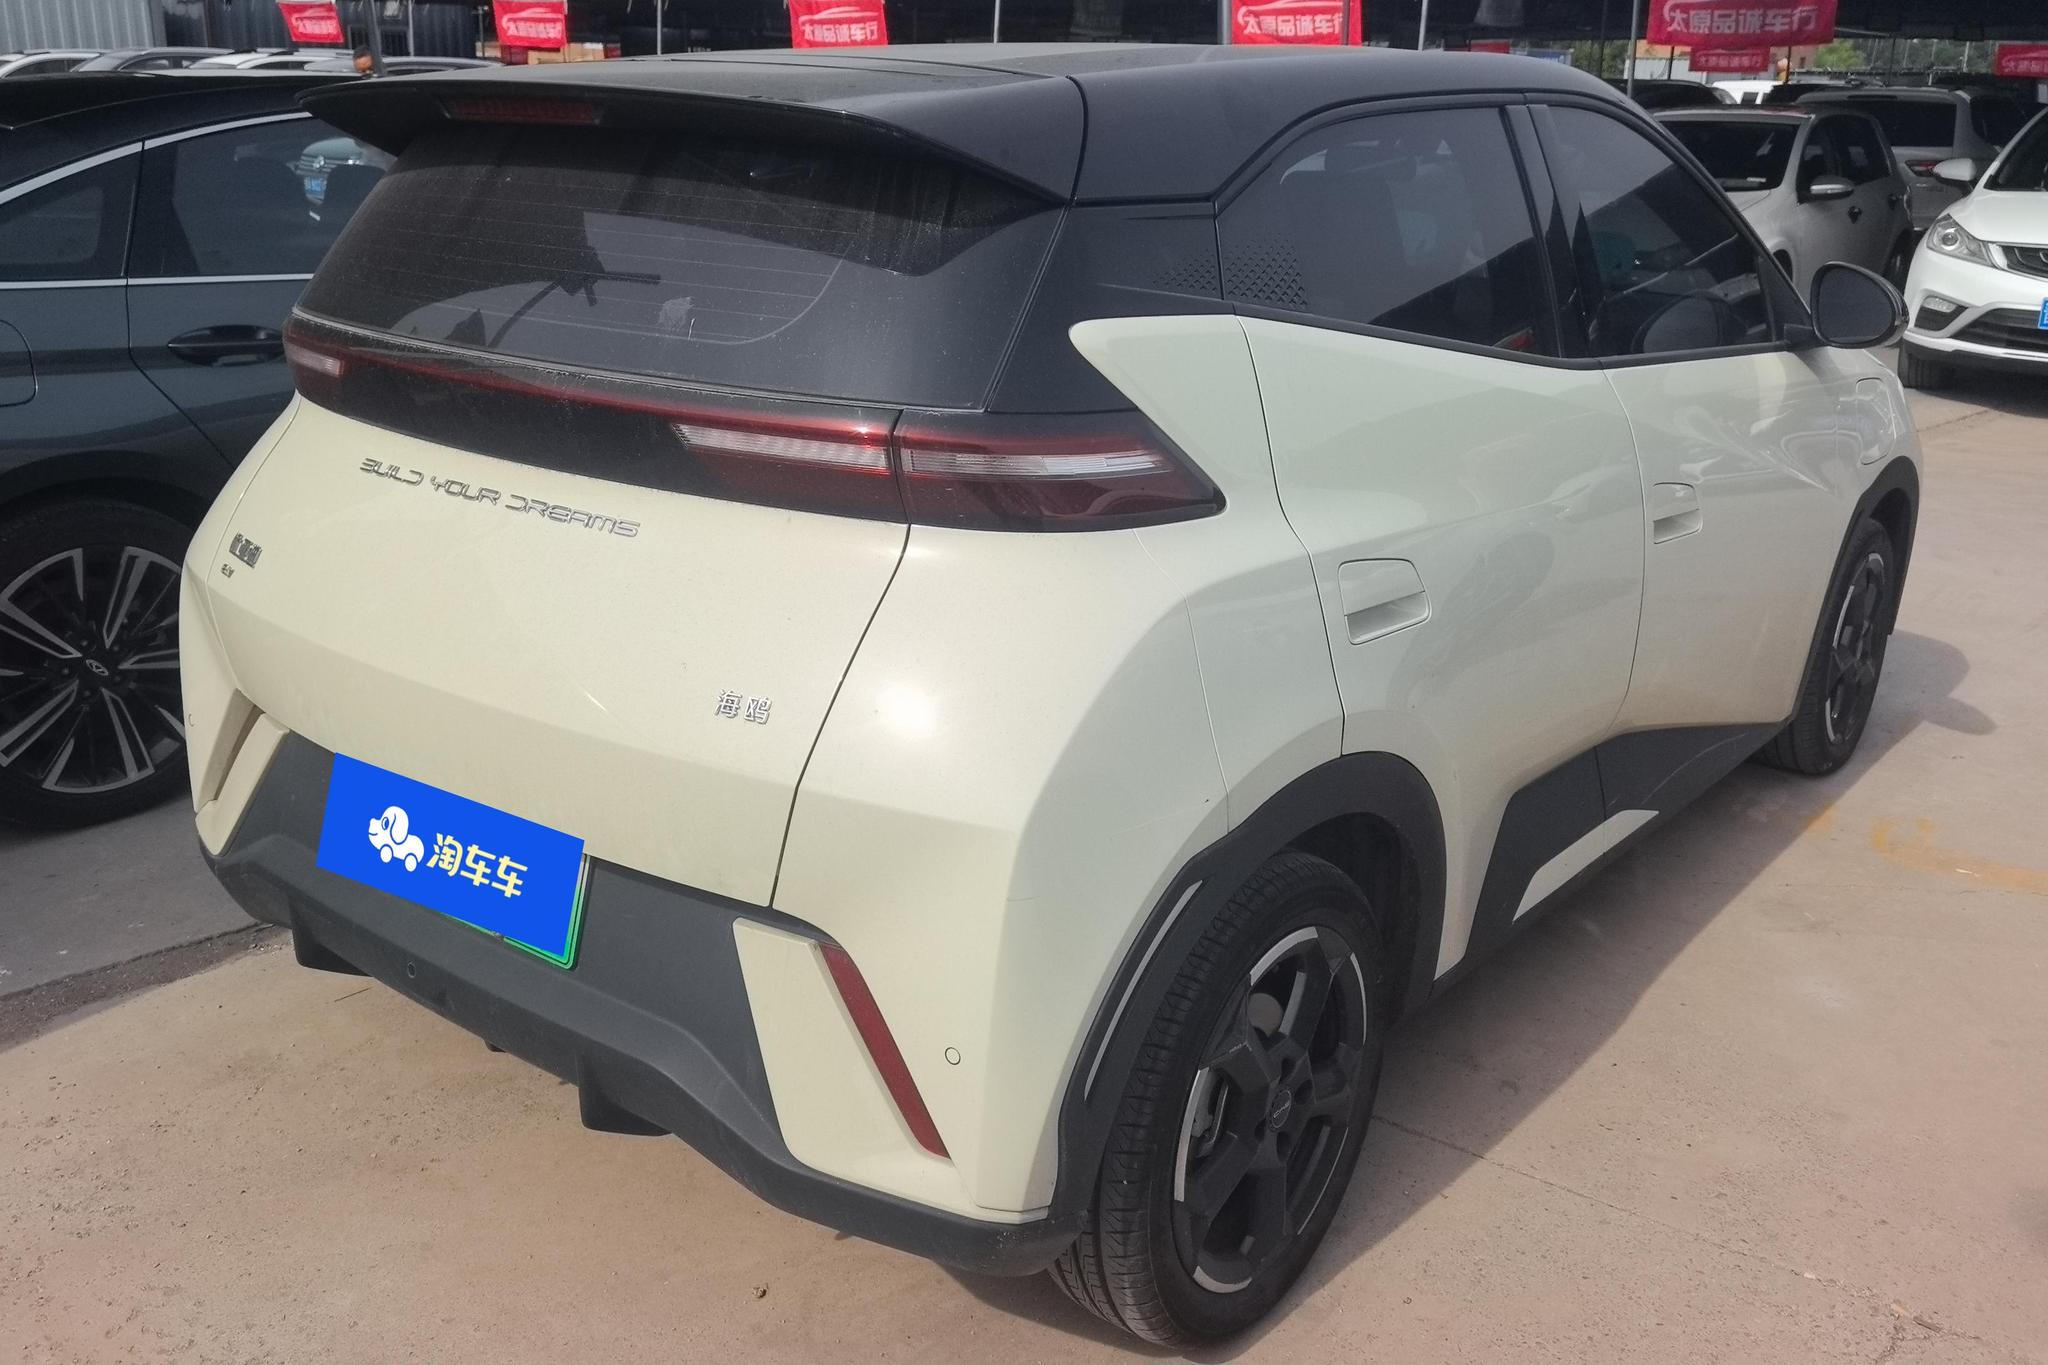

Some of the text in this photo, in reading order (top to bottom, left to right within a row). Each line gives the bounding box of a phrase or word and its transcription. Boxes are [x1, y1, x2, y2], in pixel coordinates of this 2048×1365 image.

[1667, 5, 1818, 34] 太原品诚车行
[359, 457, 641, 538] BUILD YOUR DREAMS
[714, 688, 773, 726] 海鸥
